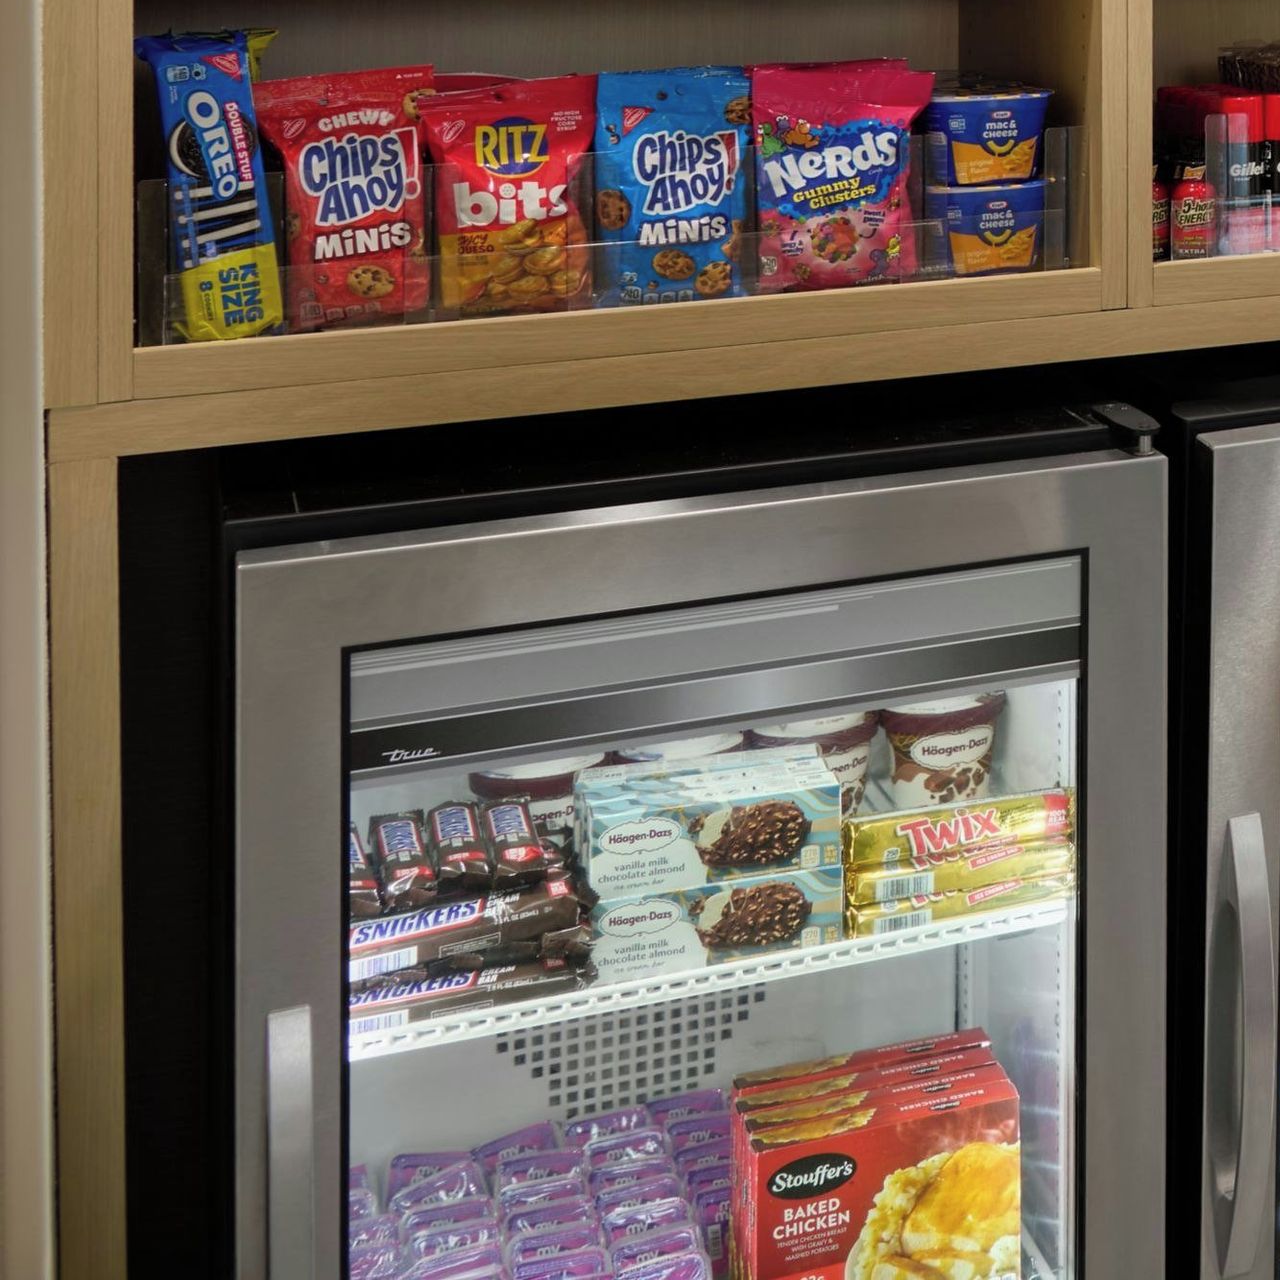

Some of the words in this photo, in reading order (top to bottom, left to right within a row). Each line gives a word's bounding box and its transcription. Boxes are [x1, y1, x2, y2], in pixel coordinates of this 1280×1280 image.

[224, 102, 247, 149] DOUBLE
[318, 109, 395, 132] CHEWY
[986, 121, 1007, 129] mac
[188, 91, 238, 198] OREO
[475, 124, 549, 168] RITZ
[637, 133, 721, 183] Chips
[303, 135, 400, 193] Chips
[793, 177, 861, 202] Gummy
[810, 183, 876, 210] Clusters
[453, 182, 568, 228] bits
[982, 212, 1004, 220] mac
[219, 267, 244, 327] SIZE
[239, 262, 264, 323] KING
[609, 828, 672, 845] Häagen-Dazs
[900, 809, 1000, 856] Twix
[598, 870, 646, 884] chocolate
[648, 864, 685, 877] almond
[614, 860, 646, 871] vanilla
[648, 858, 668, 867] milk
[355, 901, 478, 945] SNICKERS
[609, 910, 672, 927] Häagen-Dazs
[598, 952, 646, 966] chocolate
[648, 946, 685, 959] almond
[614, 942, 646, 954] vanilla
[648, 940, 668, 949] milk
[772, 1162, 853, 1192] Stouffer's
[784, 1198, 840, 1222] BAKED
[773, 1212, 850, 1240] CHICKEN
